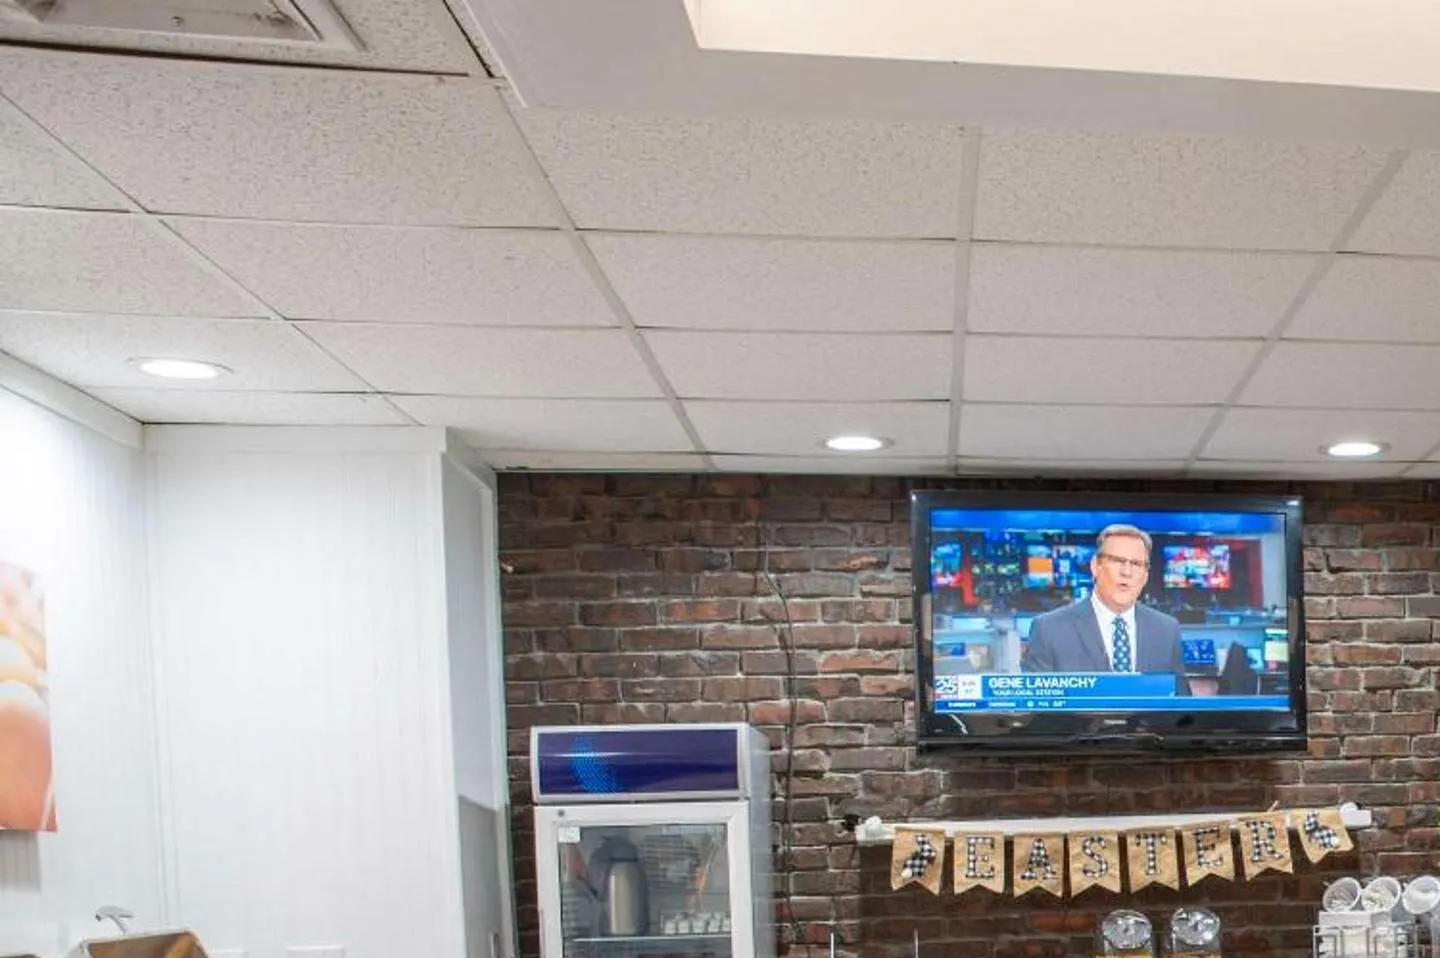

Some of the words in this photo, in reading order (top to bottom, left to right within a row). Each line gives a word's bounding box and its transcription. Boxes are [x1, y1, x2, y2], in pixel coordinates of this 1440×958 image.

[988, 676, 1024, 689] GENE
[1026, 677, 1097, 689] LAVANCHY
[965, 819, 1281, 882] EASTER
